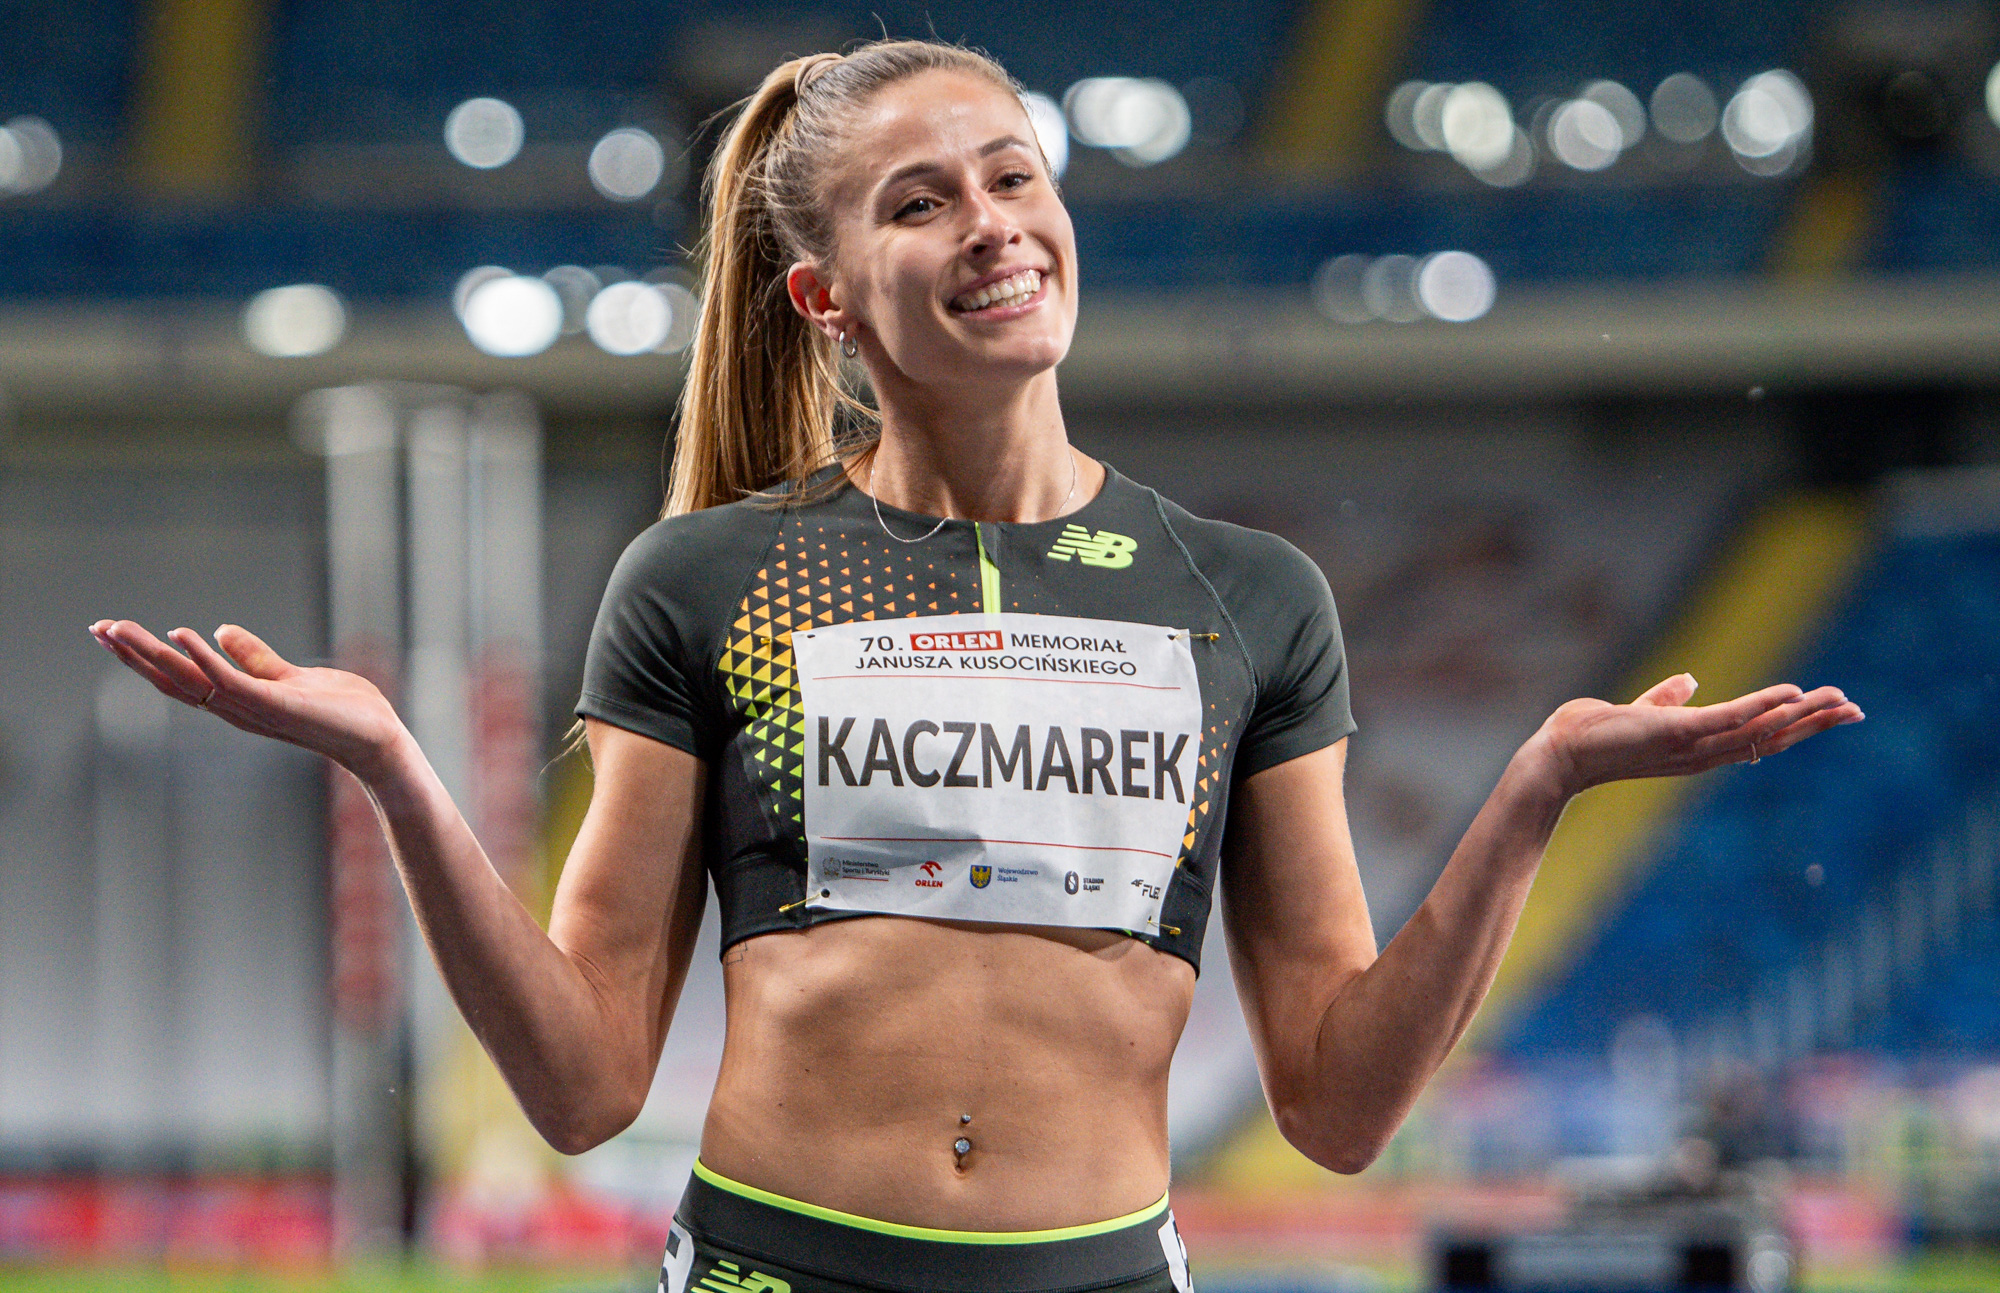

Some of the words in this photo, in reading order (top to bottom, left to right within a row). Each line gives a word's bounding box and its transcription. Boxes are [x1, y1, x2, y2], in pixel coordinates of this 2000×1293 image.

[860, 636, 903, 652] 70.
[915, 633, 998, 650] ORLEN
[1011, 633, 1127, 653] MEMORIAŁ
[855, 655, 953, 669] JANUSZA
[960, 653, 1137, 676] KUSOCIŃSKIEGO
[818, 716, 1190, 804] KACZMAREK
[915, 879, 943, 888] ORLEN
